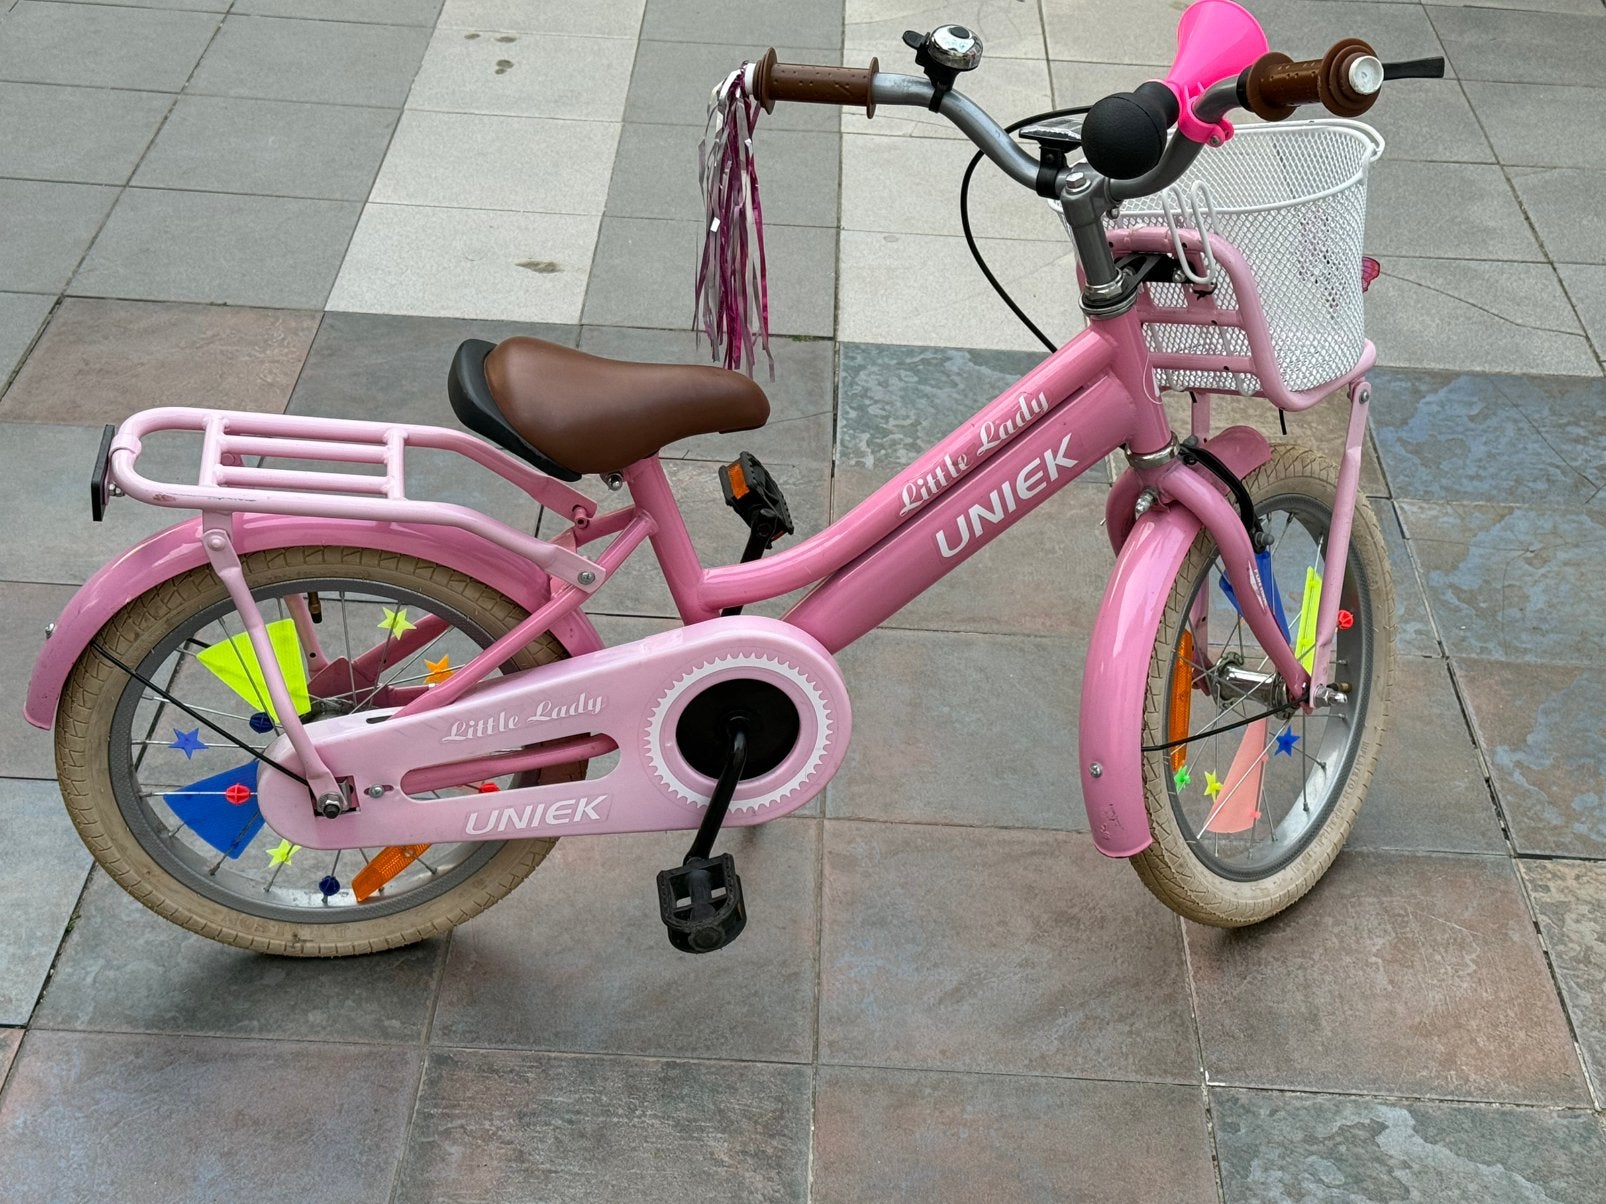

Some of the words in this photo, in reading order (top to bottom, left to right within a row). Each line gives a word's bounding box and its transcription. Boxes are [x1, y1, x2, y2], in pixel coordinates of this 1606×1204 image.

[900, 453, 973, 517] Little
[976, 391, 1050, 457] Lady
[935, 432, 1079, 559] UNIEK
[442, 712, 520, 743] Little
[526, 692, 603, 723] Lady
[465, 795, 608, 835] UNIEK
